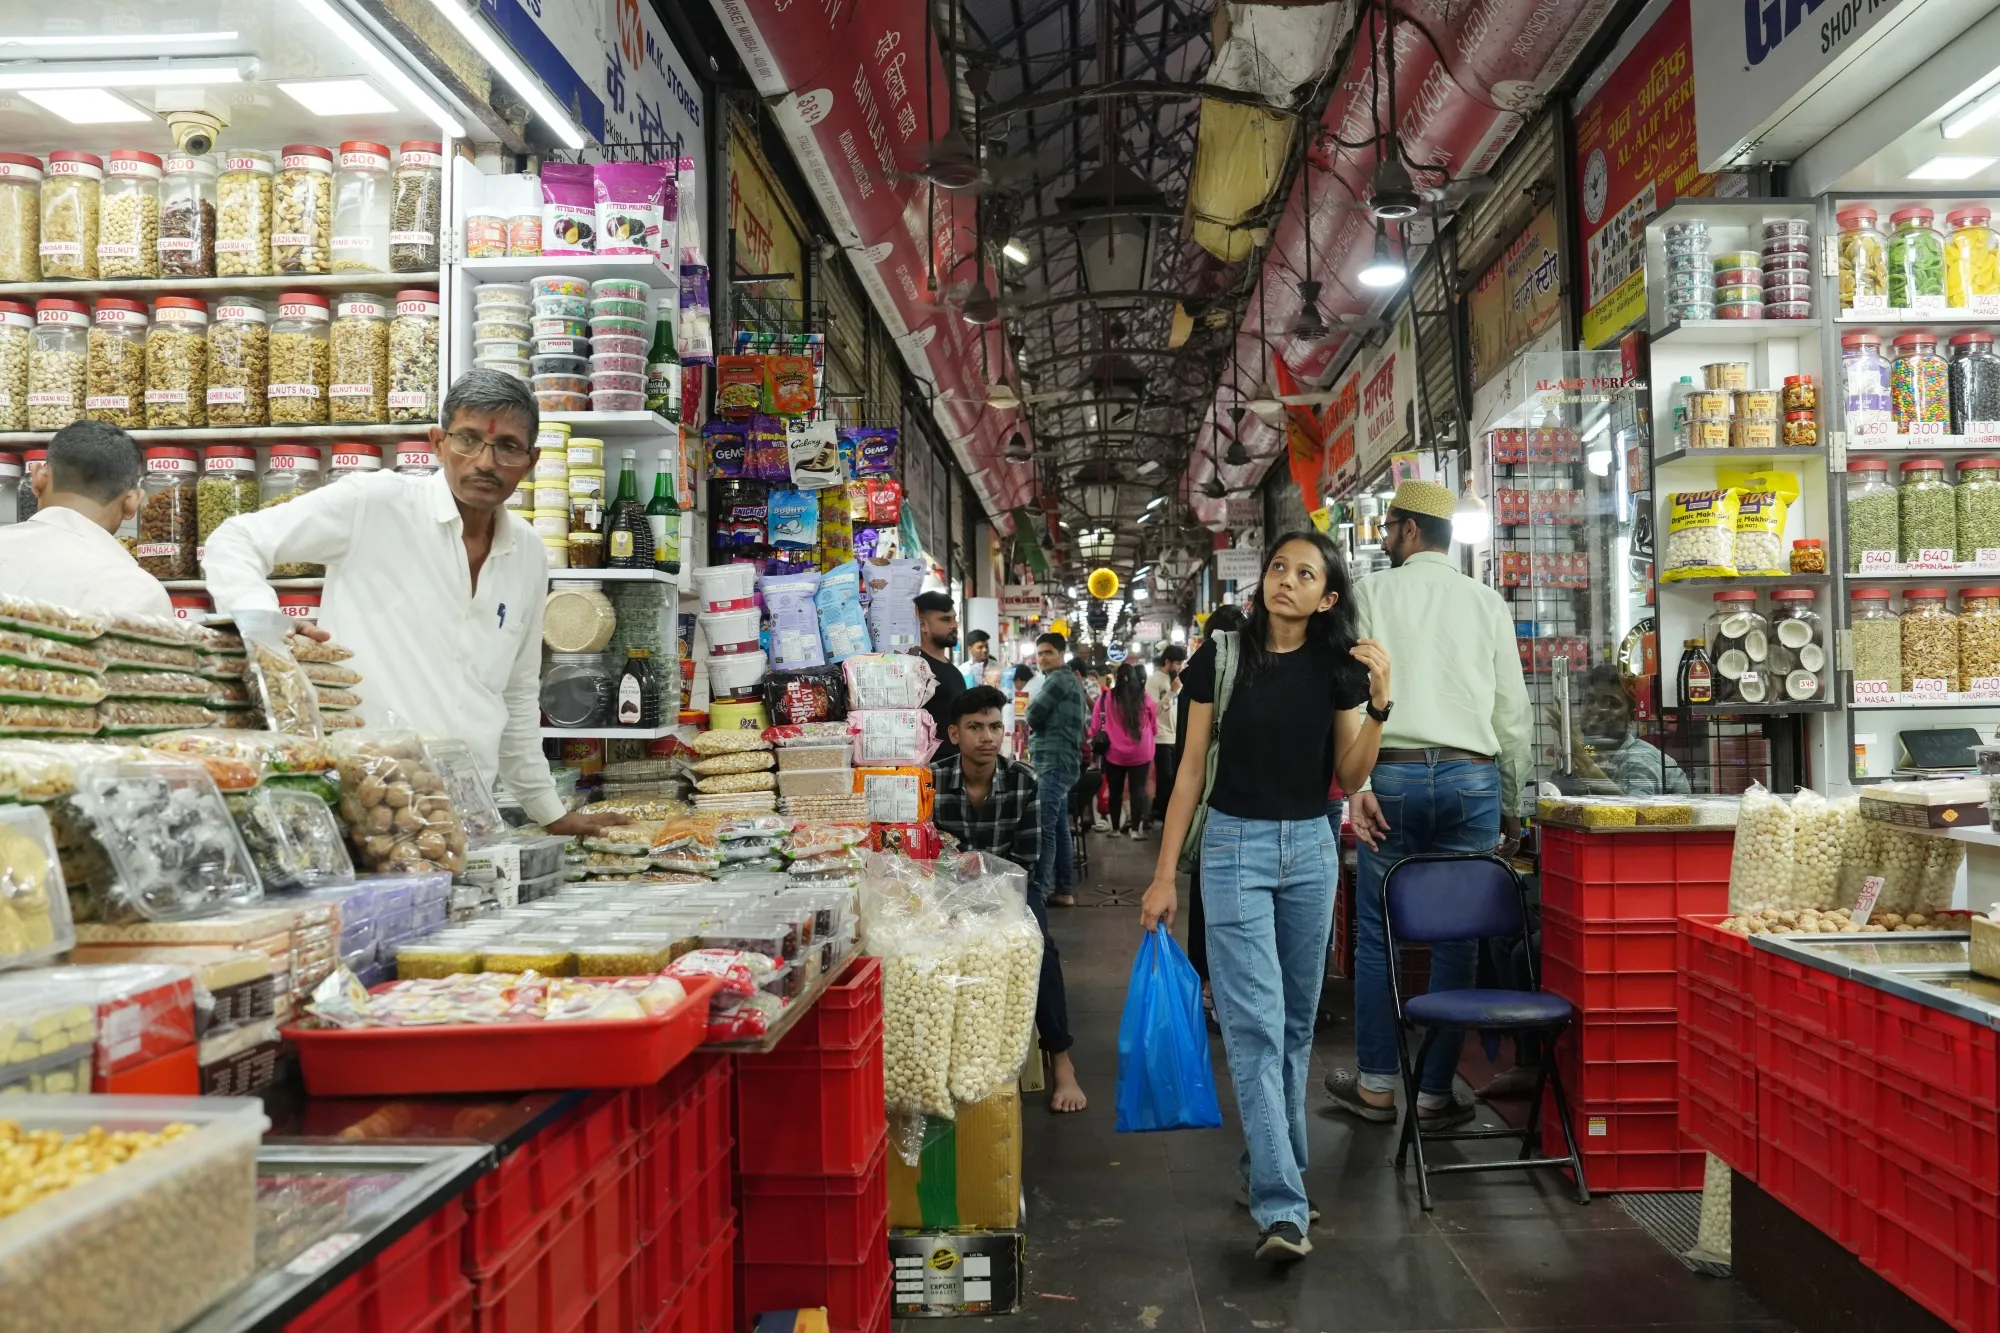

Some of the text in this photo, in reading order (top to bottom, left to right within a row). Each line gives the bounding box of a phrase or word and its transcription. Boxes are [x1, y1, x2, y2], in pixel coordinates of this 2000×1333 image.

[1456, 7, 1488, 64] SAEED
[1511, 3, 1554, 58] PROVISION
[736, 26, 760, 54] MUMBAI
[667, 64, 701, 128] STORES
[852, 62, 872, 115] RAVI
[865, 95, 885, 151] VILAS
[838, 128, 857, 164] KIRANA
[1617, 110, 1661, 172] AL-ALIF
[111, 161, 138, 172] 1800
[575, 208, 597, 217] PRUNE
[606, 203, 653, 212] PITTED PRUNES
[158, 240, 195, 250] ECANNUT
[351, 238, 370, 246] NUT
[98, 246, 136, 255] AZELNUT
[1858, 296, 1884, 308] 540
[216, 306, 245, 318] 1200
[280, 304, 307, 317] 1200
[349, 303, 375, 316] 800
[397, 302, 427, 315] 1000
[1972, 307, 2000, 315] MANGO
[38, 310, 69, 322] 1200
[354, 385, 372, 394] KANI
[1534, 377, 1588, 391] AL-ALIF
[169, 391, 184, 401] WHITE
[267, 384, 297, 397] ALNUTS
[110, 398, 126, 408] WHITE
[412, 394, 424, 405] MIX
[1366, 400, 1395, 444] MARWAH
[1965, 422, 1995, 434] 1100
[1912, 422, 1940, 435] 300
[790, 437, 822, 450] Galaxy
[1863, 436, 1888, 446] KESAR
[1911, 437, 1935, 445] GEMS
[716, 446, 746, 460] GEMS
[864, 445, 889, 455] GEMS
[150, 459, 180, 471] 1400
[271, 456, 295, 469] 1000
[335, 454, 359, 466] 400
[404, 453, 429, 465] 320
[734, 506, 766, 518] SNICKERS
[773, 506, 808, 515] BOUNTY
[1671, 513, 1694, 525] Organic
[1866, 551, 1892, 563] 640
[1923, 550, 1949, 561] 640
[1800, 680, 1815, 688] 340
[1855, 681, 1889, 694] 6000
[1915, 679, 1943, 691] 460
[1973, 678, 2000, 690] 460
[1863, 694, 1896, 704] MASALA
[1902, 692, 1948, 700] KHARIK SLICE
[1961, 691, 1987, 700] KHARIK
[789, 680, 802, 725] SUPER
[803, 688, 817, 722] SPICY
[1861, 880, 1880, 895] 680
[929, 1283, 957, 1291] EXPORT
